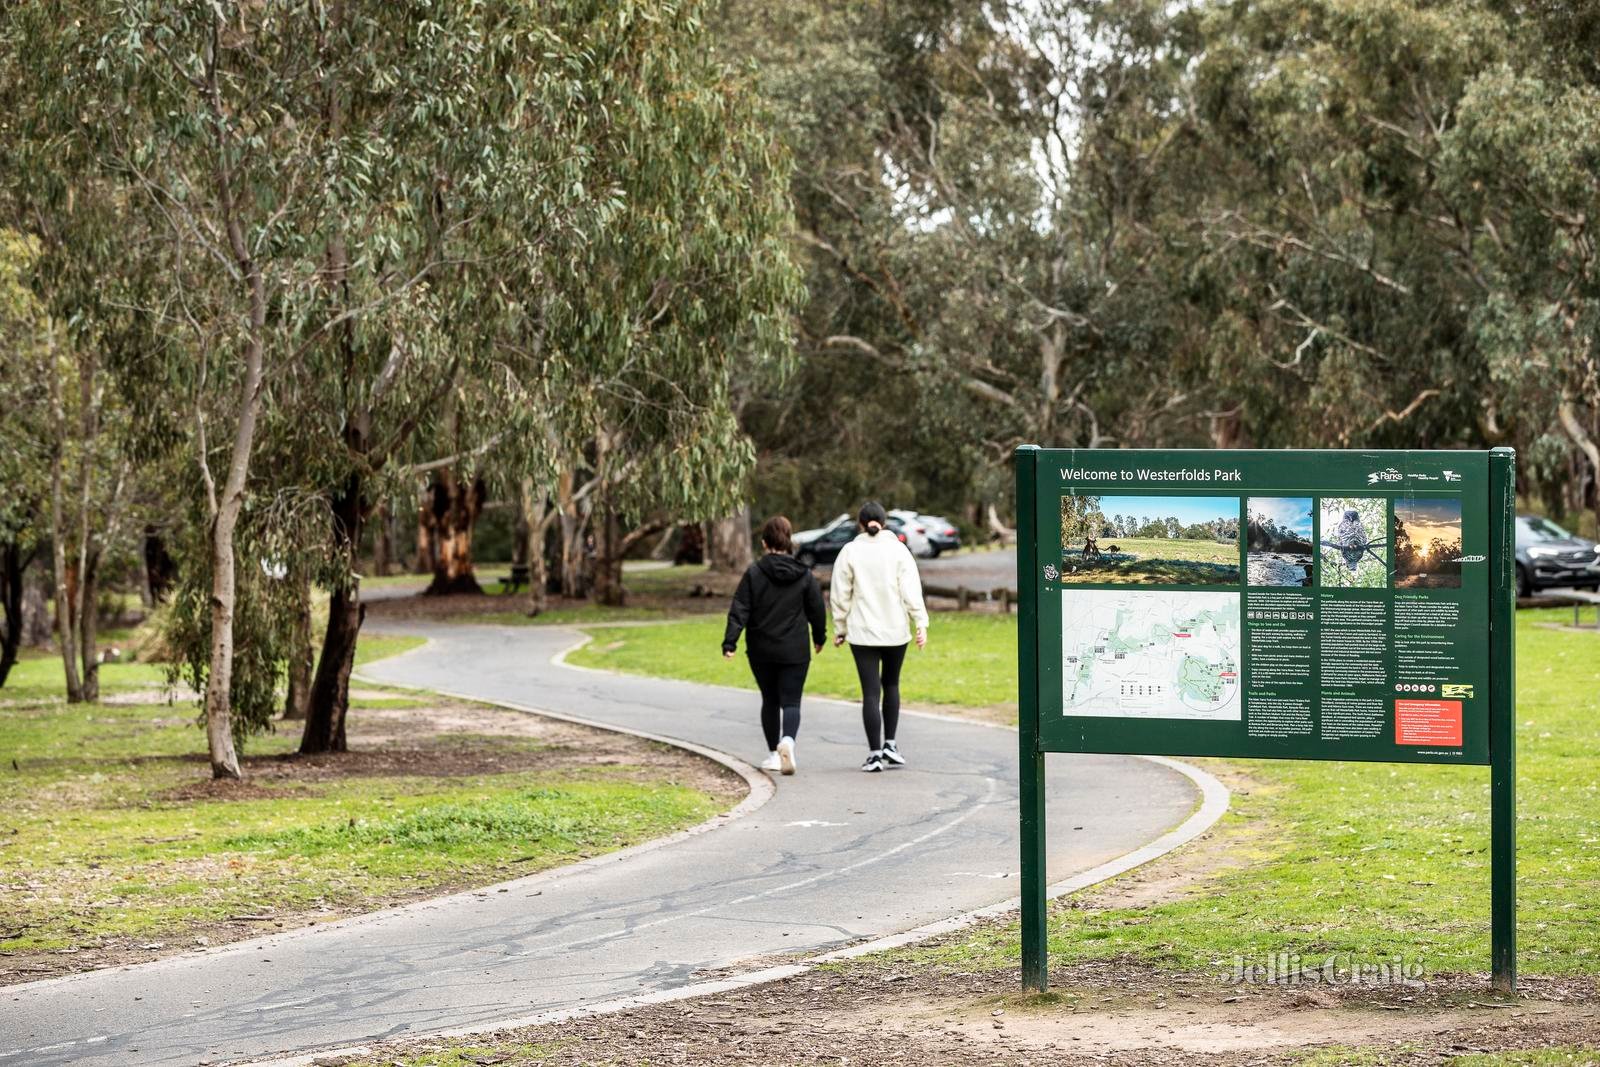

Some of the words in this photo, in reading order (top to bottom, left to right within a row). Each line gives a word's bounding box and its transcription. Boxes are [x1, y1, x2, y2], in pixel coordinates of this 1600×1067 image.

[1060, 468, 1117, 480] Welcome
[1120, 469, 1134, 480] to
[1137, 469, 1211, 481] Westerfolds
[1214, 469, 1242, 481] Park
[1380, 472, 1403, 480] Parks
